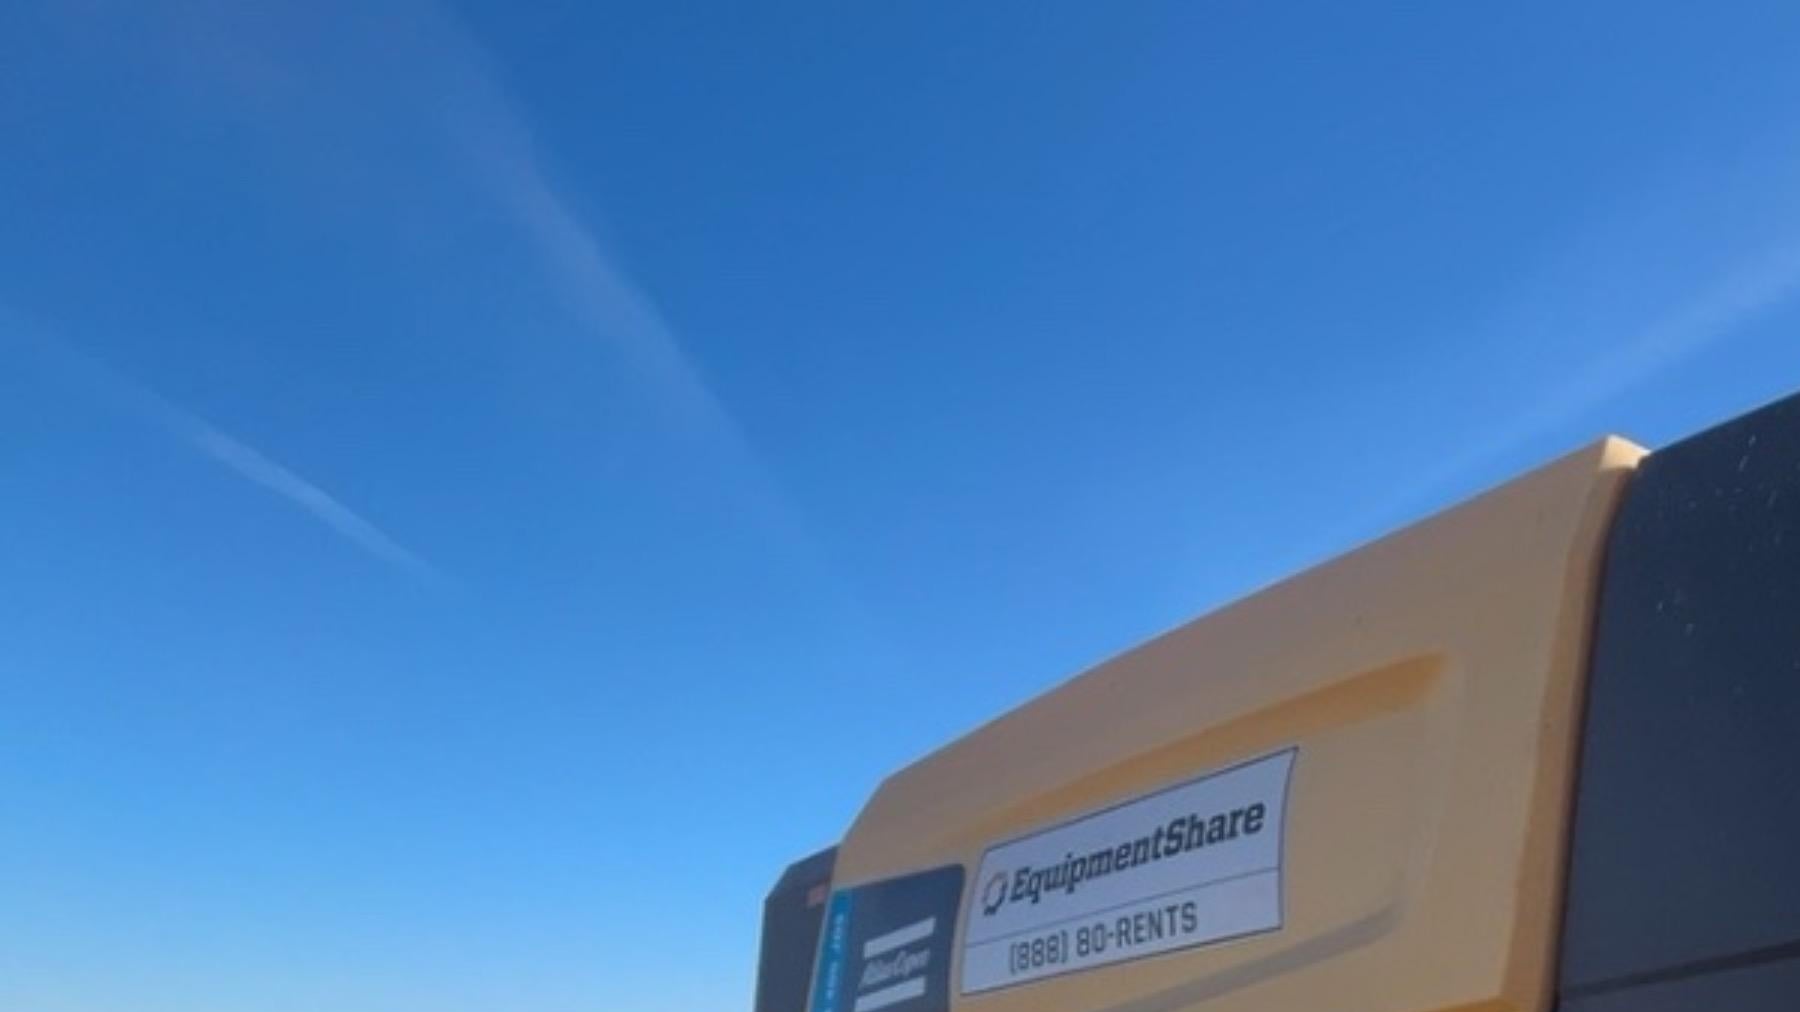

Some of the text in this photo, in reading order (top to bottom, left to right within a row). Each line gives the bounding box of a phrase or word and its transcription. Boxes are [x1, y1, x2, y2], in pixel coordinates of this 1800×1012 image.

[1009, 802, 1265, 904] EquipmentShare
[1009, 901, 1197, 975] (888) 80-RENTS
